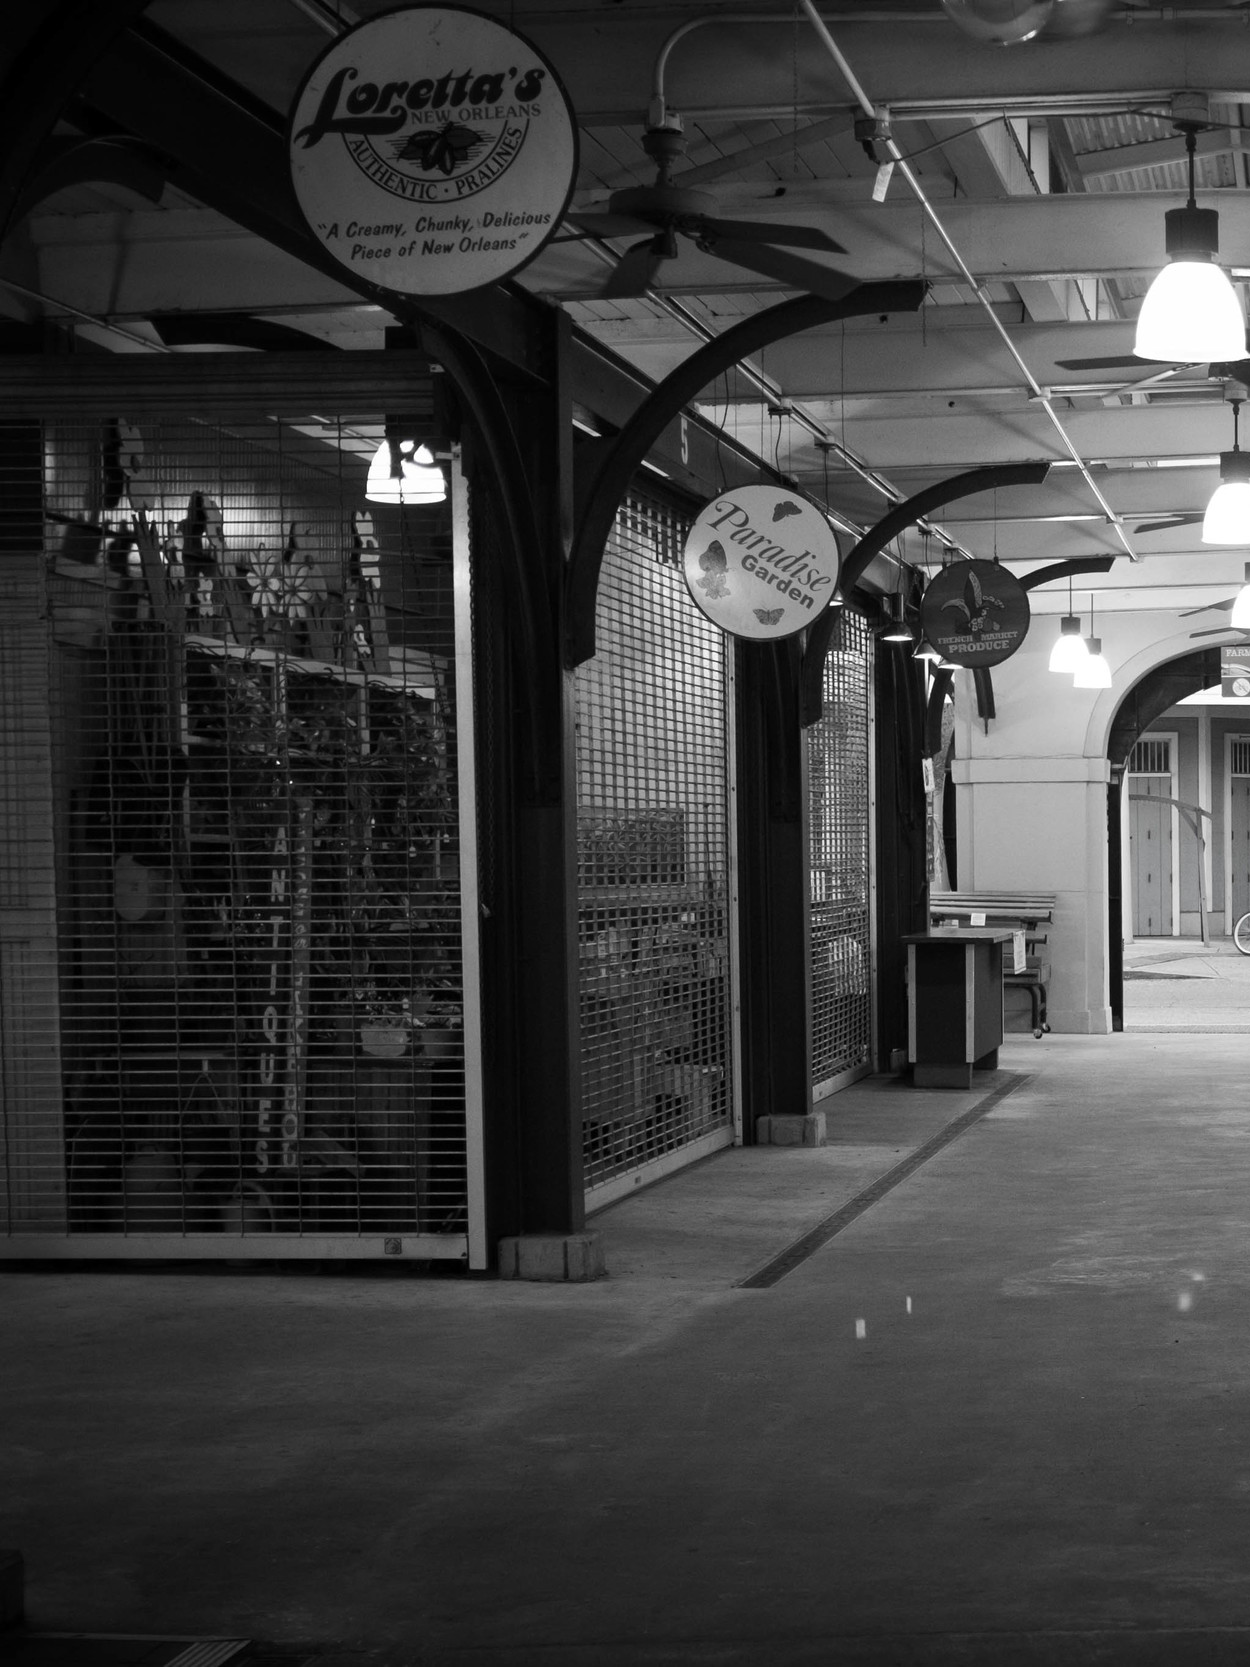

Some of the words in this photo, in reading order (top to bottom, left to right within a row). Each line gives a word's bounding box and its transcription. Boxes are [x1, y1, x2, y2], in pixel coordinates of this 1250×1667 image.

[294, 67, 546, 149] Loretta's
[411, 109, 450, 125] NEW
[458, 103, 542, 121] ORLEANS
[349, 138, 438, 200] AUTHENTIC
[455, 126, 522, 196] PRALINES
[346, 221, 407, 238] Creamy,
[415, 214, 475, 234] Chunky,
[482, 211, 551, 228] Delicious
[351, 244, 391, 260] Piece
[398, 240, 416, 257] of
[421, 238, 454, 255] New
[459, 231, 529, 252] Orleans"
[680, 416, 688, 465] 5
[706, 500, 832, 592] Paradise
[741, 554, 815, 609] Garden
[938, 635, 973, 645] FRENCH
[981, 631, 1018, 641] MARKET
[948, 640, 1010, 653] PRODUCE
[255, 826, 289, 1174] ANTIQUES
